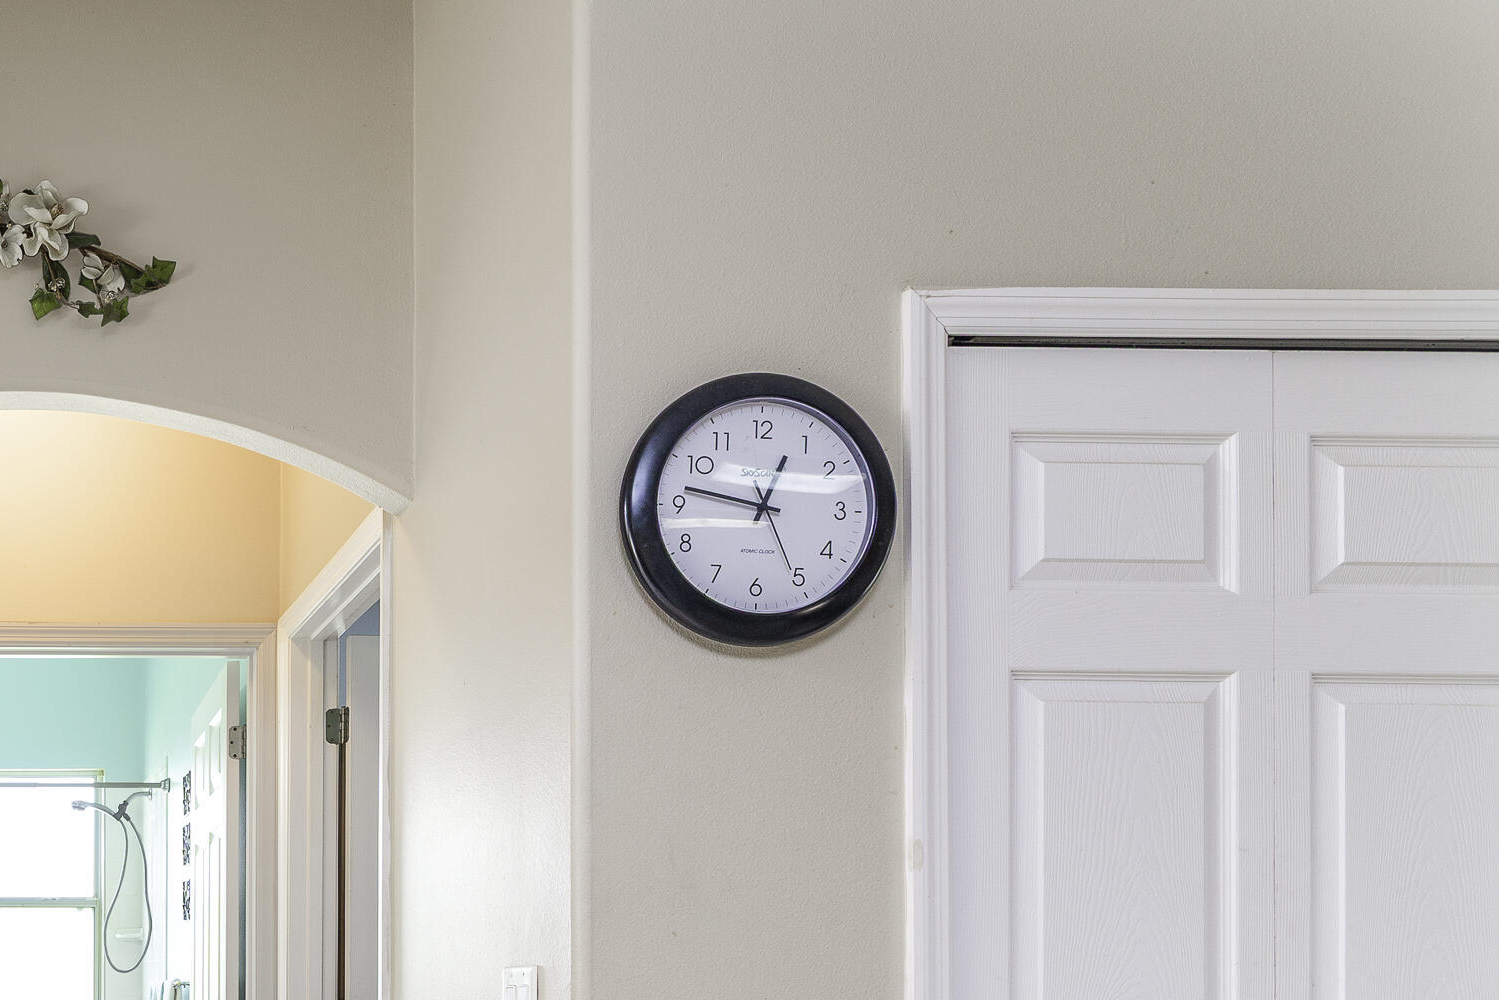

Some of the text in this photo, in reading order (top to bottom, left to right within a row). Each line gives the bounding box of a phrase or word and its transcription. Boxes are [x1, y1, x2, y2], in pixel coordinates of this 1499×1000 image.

[752, 420, 773, 440] 12
[712, 431, 730, 451] 11
[801, 435, 808, 454] 1
[687, 455, 714, 474] 10
[823, 461, 836, 480] 2
[672, 495, 686, 514] 9
[833, 501, 847, 521] 3
[680, 533, 692, 553] 8
[819, 540, 833, 560] 4
[710, 564, 723, 584] 7
[792, 567, 806, 587] 5
[749, 577, 763, 597] 6
